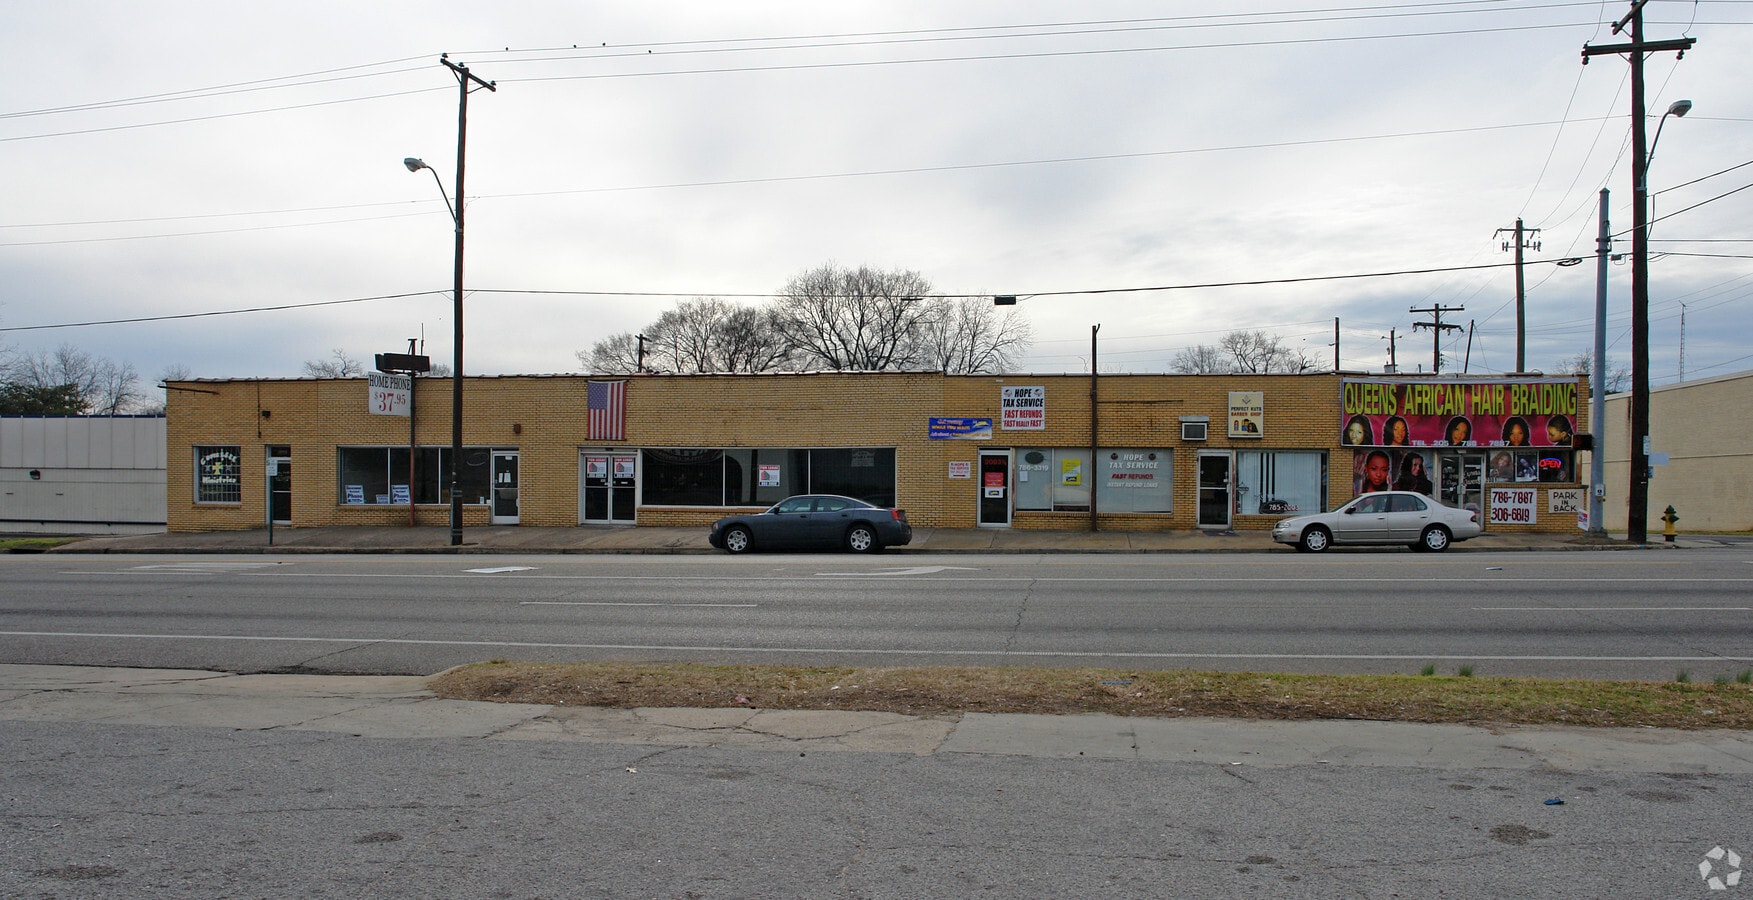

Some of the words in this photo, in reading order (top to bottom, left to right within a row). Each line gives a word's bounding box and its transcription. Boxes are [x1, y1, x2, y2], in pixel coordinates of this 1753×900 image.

[369, 374, 389, 389] HOME
[390, 376, 411, 391] PHONE
[1014, 388, 1032, 398] HOPE
[1003, 398, 1015, 408] TAX
[1016, 398, 1044, 408] SERVICE
[1344, 383, 1398, 415] QUEENS
[1403, 384, 1465, 416] AFRICAN
[1471, 384, 1505, 415] HAIR
[1511, 383, 1577, 415] BRAIDING
[1004, 409, 1019, 419] FAST
[1019, 409, 1043, 419] REFUNDS
[1123, 453, 1144, 461] HOPE
[1109, 461, 1123, 469] TAX
[1126, 461, 1159, 469] SERVICE
[1539, 459, 1561, 469] OPEN
[1553, 504, 1577, 512] BACK
